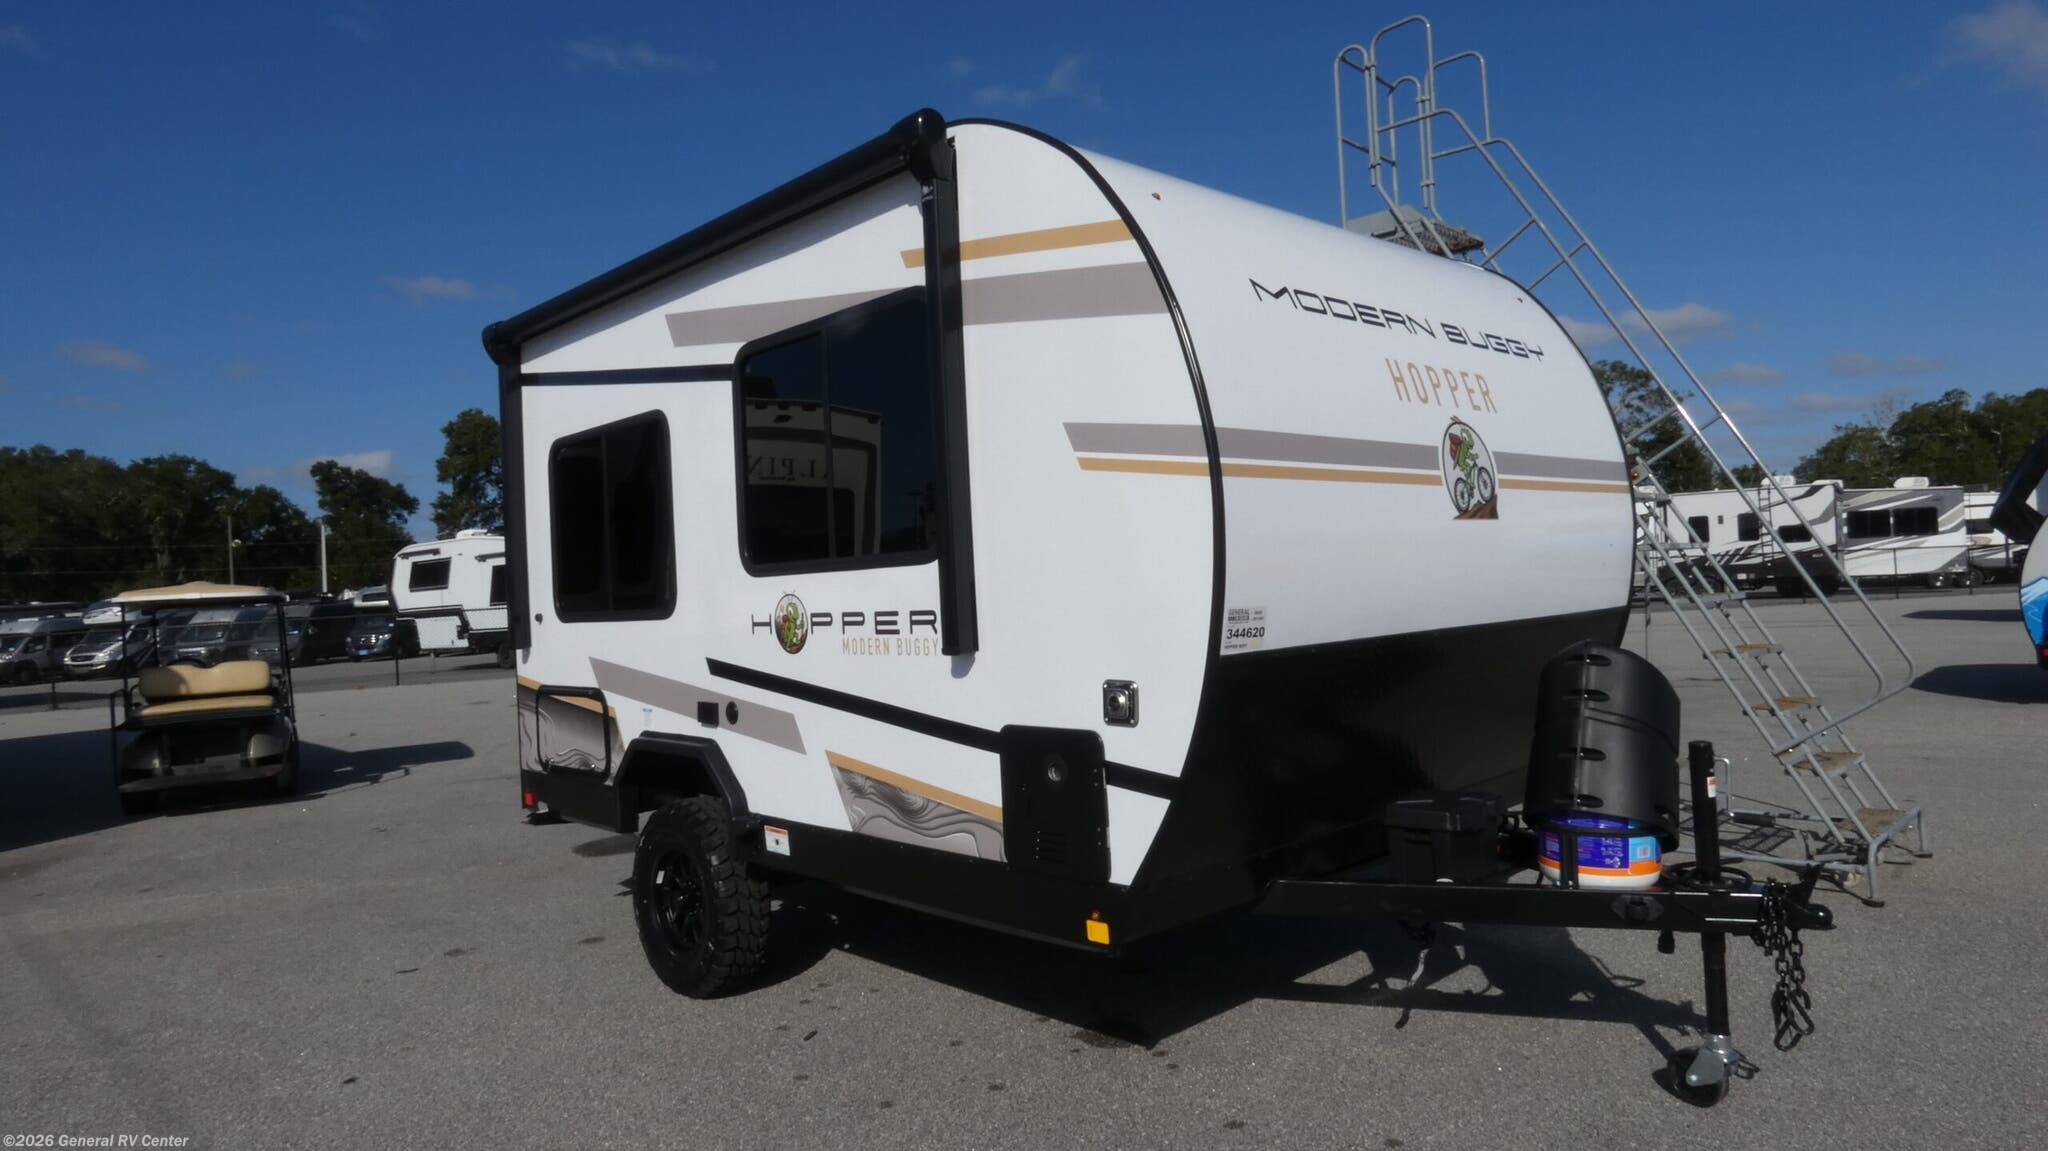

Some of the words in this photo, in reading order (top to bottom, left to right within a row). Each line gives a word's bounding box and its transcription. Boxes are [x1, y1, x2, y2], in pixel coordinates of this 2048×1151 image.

[1249, 278, 1437, 339] MODERN
[1440, 322, 1545, 361] BUGGY
[1385, 358, 1498, 413] HOPPER
[842, 638, 890, 656] MODERN
[897, 637, 939, 656] BUGGY
[1226, 626, 1266, 640] 344620
